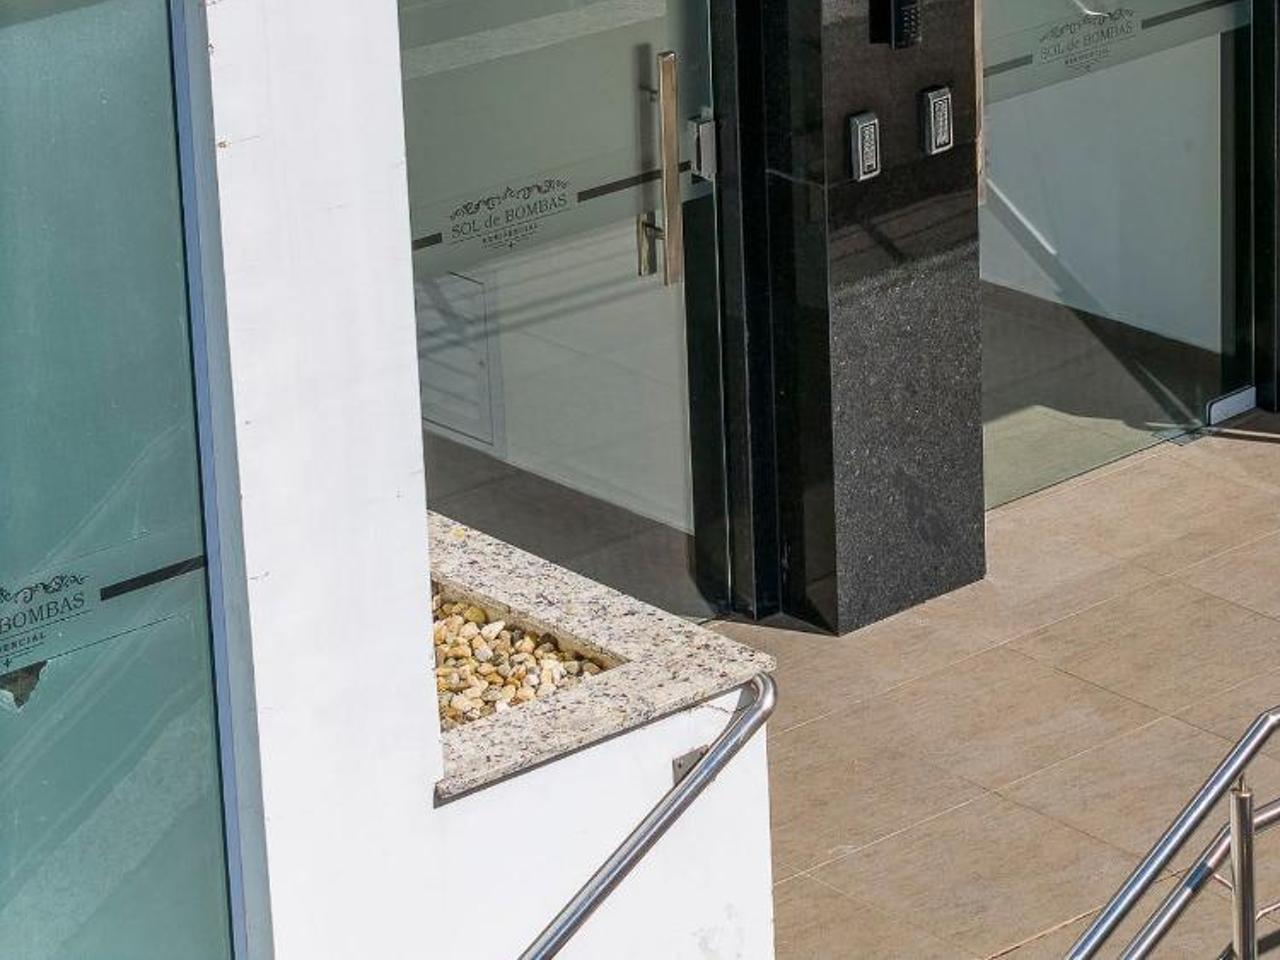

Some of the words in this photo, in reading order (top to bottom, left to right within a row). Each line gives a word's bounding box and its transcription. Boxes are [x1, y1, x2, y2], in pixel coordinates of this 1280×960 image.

[451, 219, 481, 239] SOL
[484, 214, 503, 229] de
[505, 193, 567, 222] BOMBAS
[0, 592, 85, 635] BOMBAS
